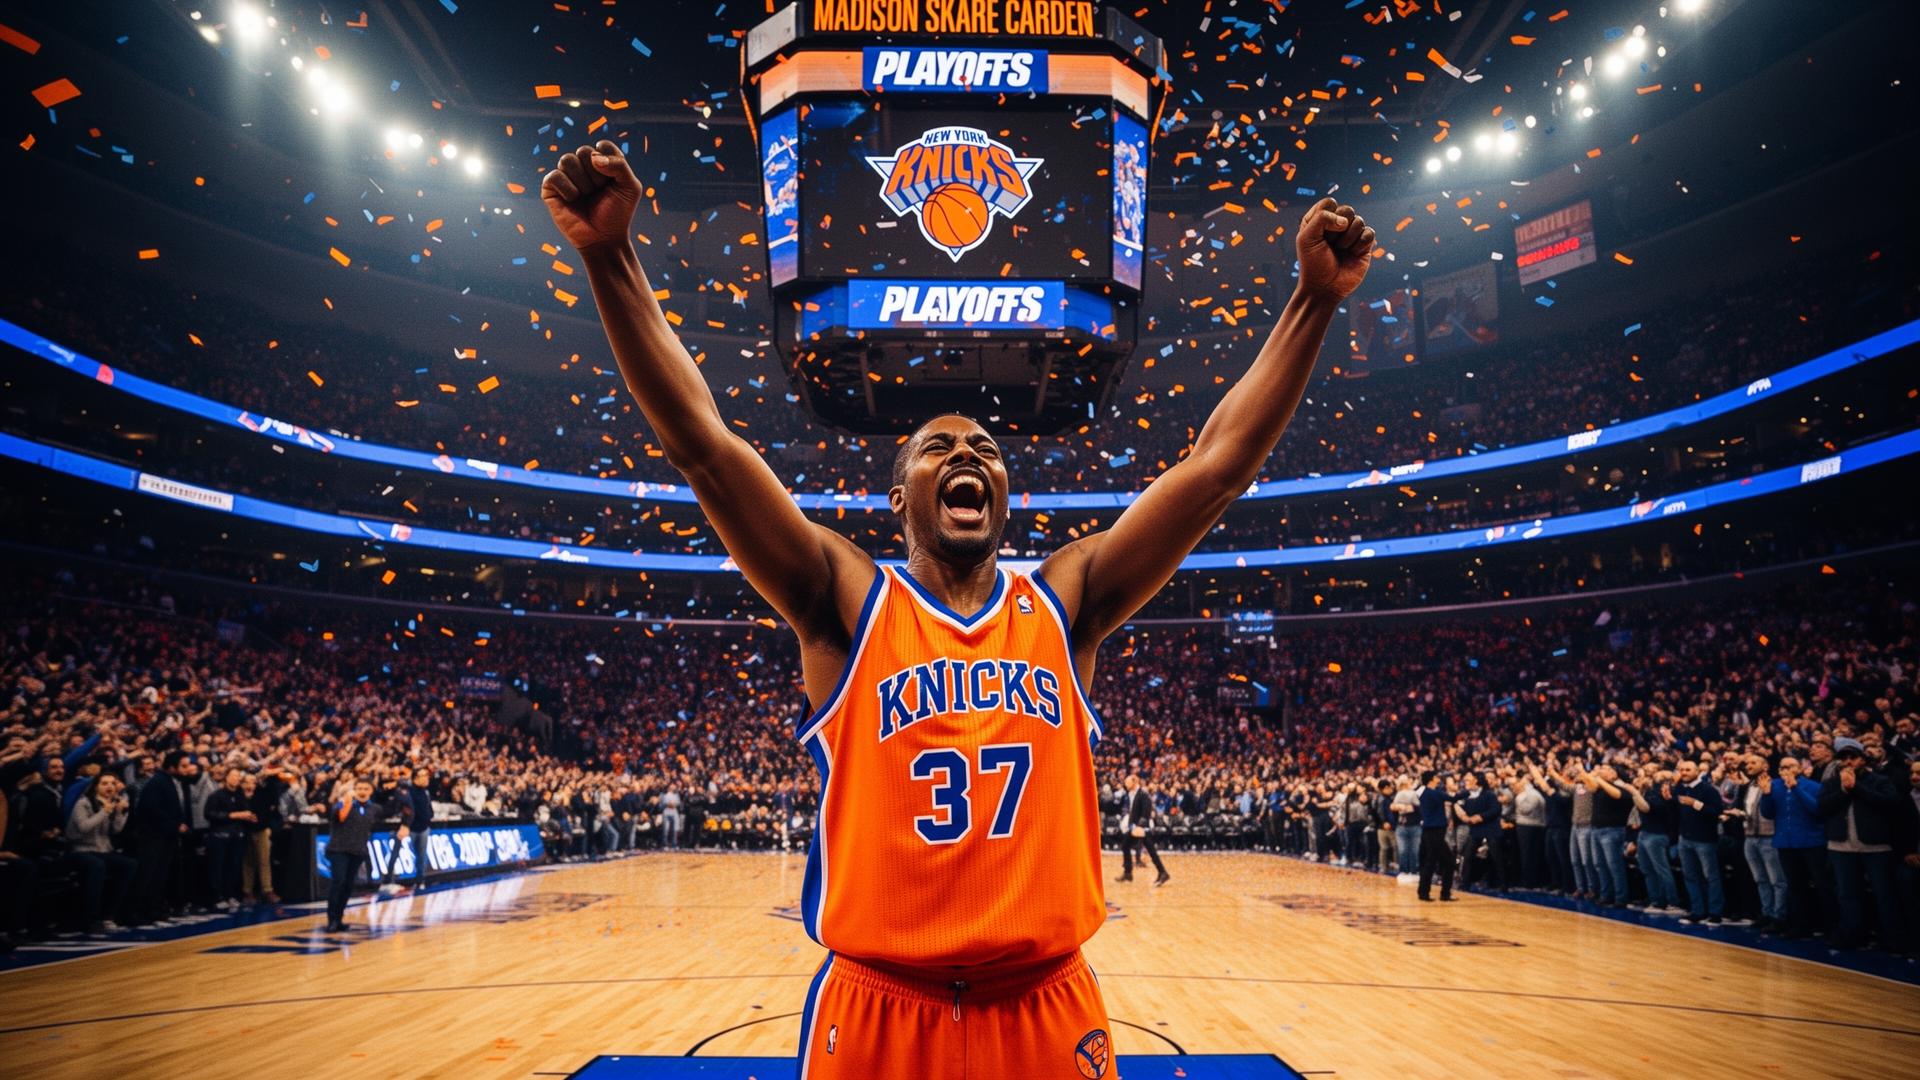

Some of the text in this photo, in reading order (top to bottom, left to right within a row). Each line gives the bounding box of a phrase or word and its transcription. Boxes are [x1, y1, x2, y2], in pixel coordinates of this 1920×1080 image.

[813, 0, 919, 32] MADISON
[925, 0, 1000, 34] SKARE
[872, 50, 1034, 88] PLAYOFFS
[924, 129, 987, 145] NEW YORK
[884, 143, 1028, 200] KNICKS
[878, 285, 1045, 323] PLAYOFFS
[876, 656, 1062, 744] KNICKS
[909, 742, 1033, 845] 37
